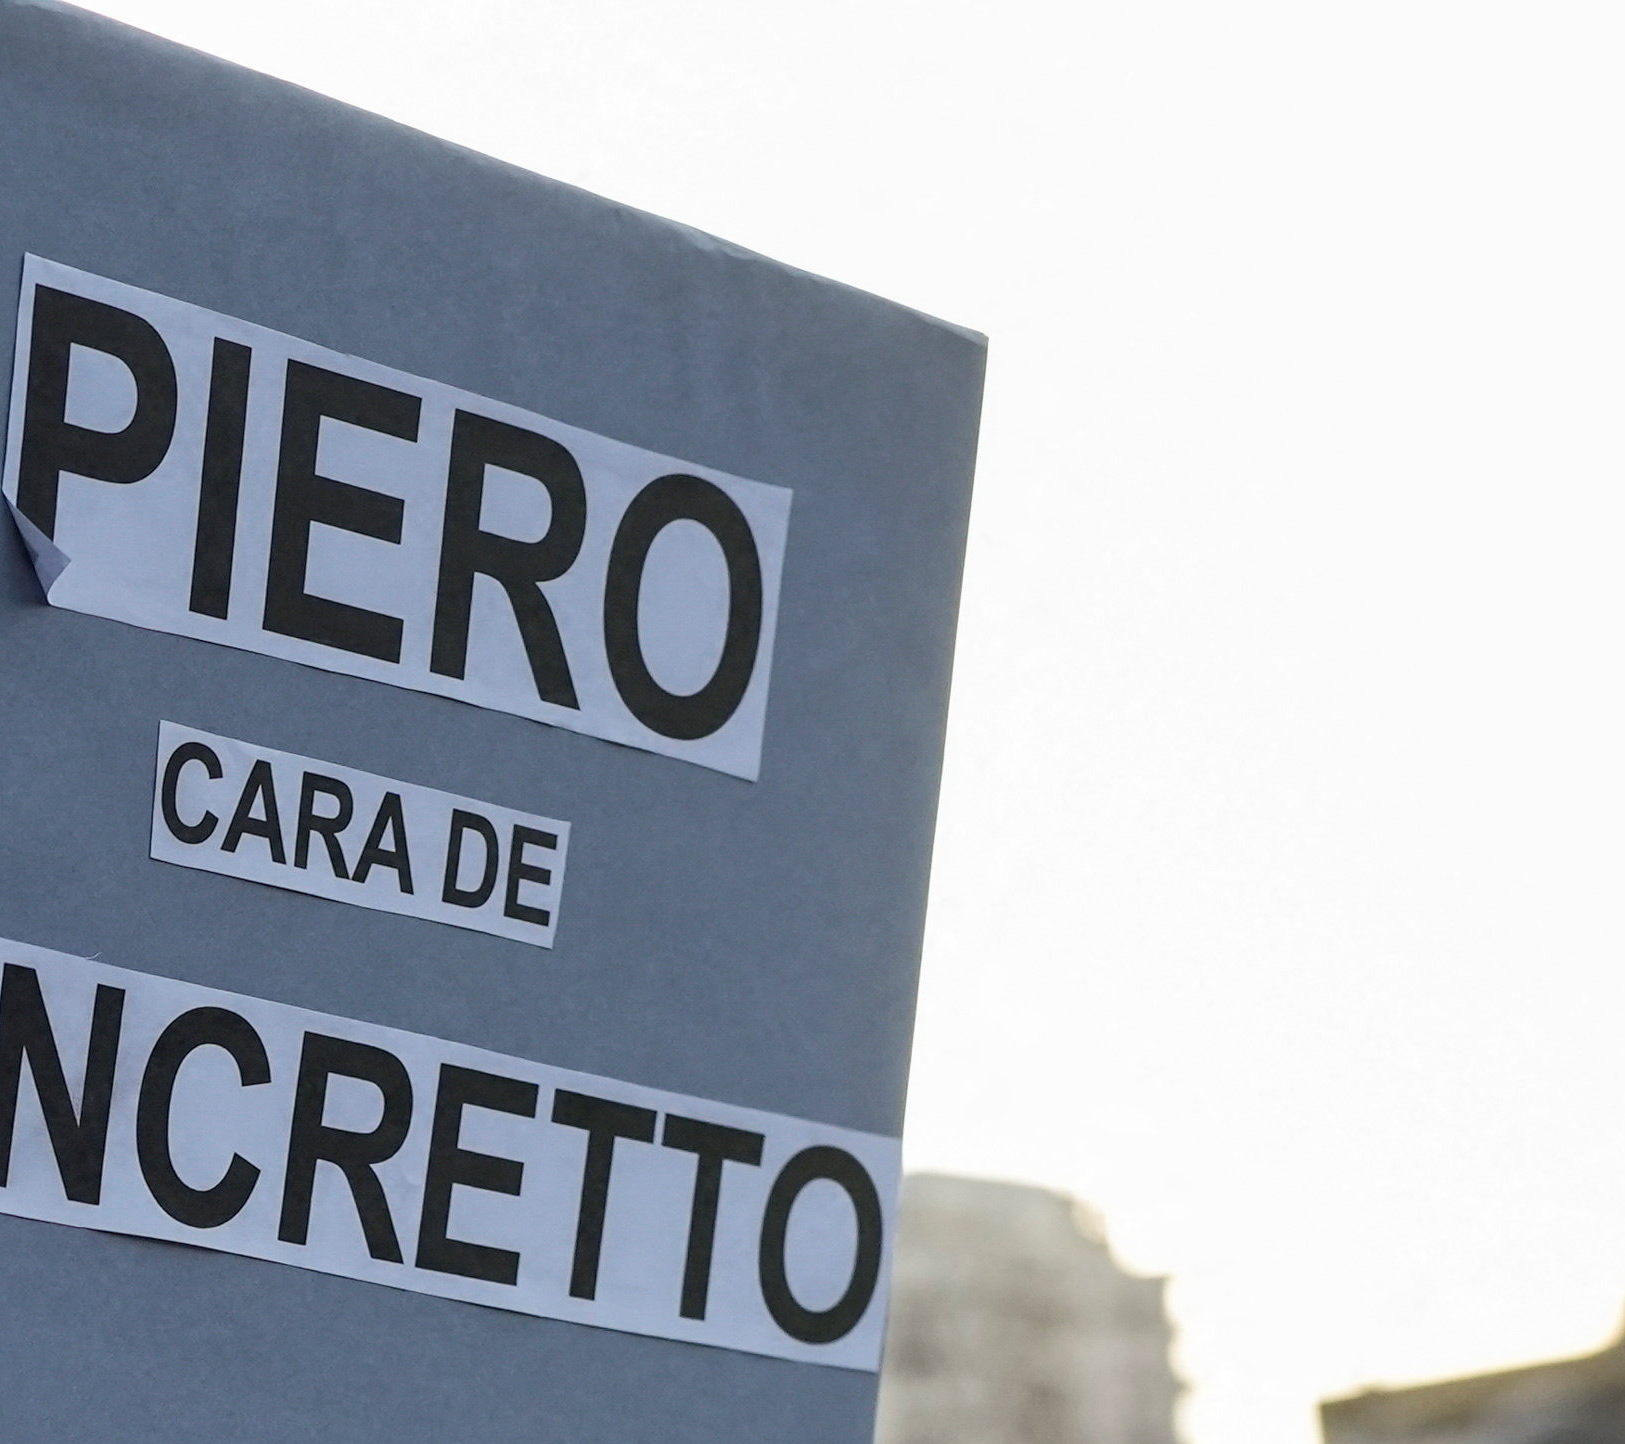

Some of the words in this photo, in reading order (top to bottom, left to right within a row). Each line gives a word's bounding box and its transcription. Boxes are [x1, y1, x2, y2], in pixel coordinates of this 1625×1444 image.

[15, 283, 764, 742] PIERO
[159, 741, 414, 896] CARA
[441, 825, 559, 927] DE
